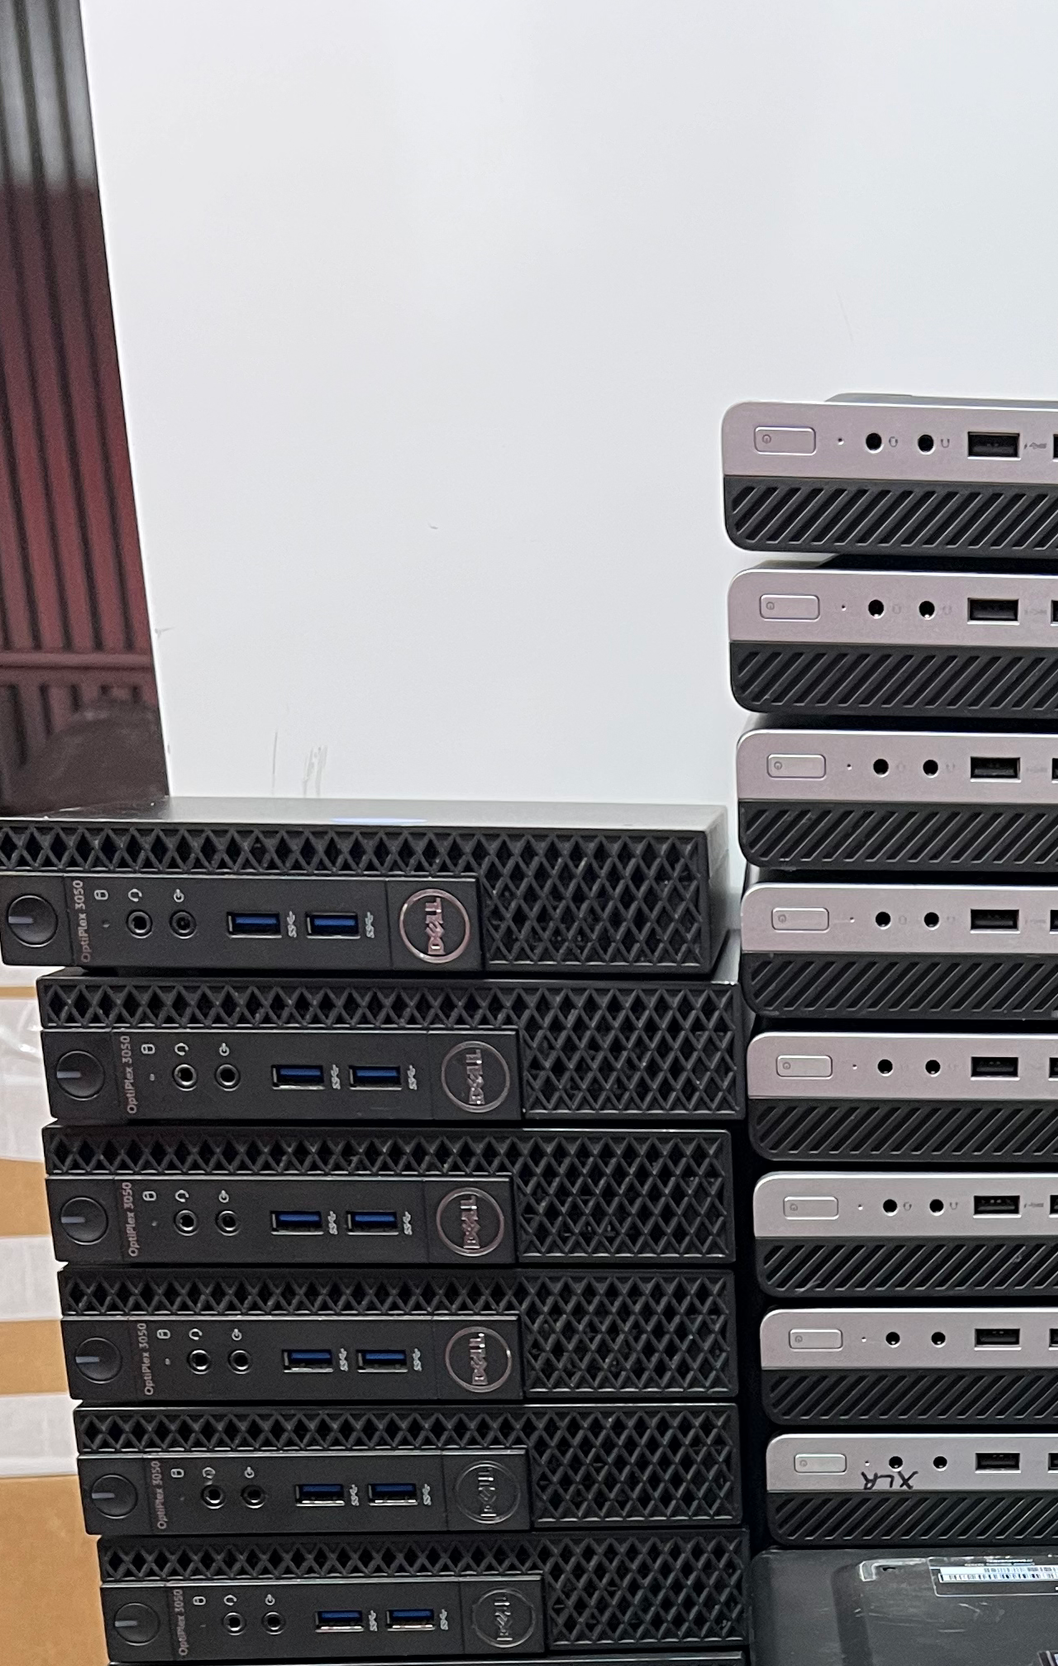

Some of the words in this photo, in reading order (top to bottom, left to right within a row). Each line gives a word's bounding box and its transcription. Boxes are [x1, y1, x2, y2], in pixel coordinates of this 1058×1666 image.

[72, 880, 86, 910] 3050
[77, 914, 91, 963] OptiPlex
[120, 1035, 132, 1064] 3050
[123, 1067, 137, 1114] OptiPlex
[122, 1181, 136, 1209] 3050
[123, 1211, 140, 1257] OptiPlex
[137, 1322, 149, 1349] 3050
[141, 1351, 155, 1396] OptiPlex
[150, 1460, 163, 1486] 3050
[861, 1470, 918, 1490] XLR
[154, 1487, 168, 1530] OptiPlex
[173, 1589, 185, 1613] 3050
[176, 1615, 189, 1656] OptiPlex
